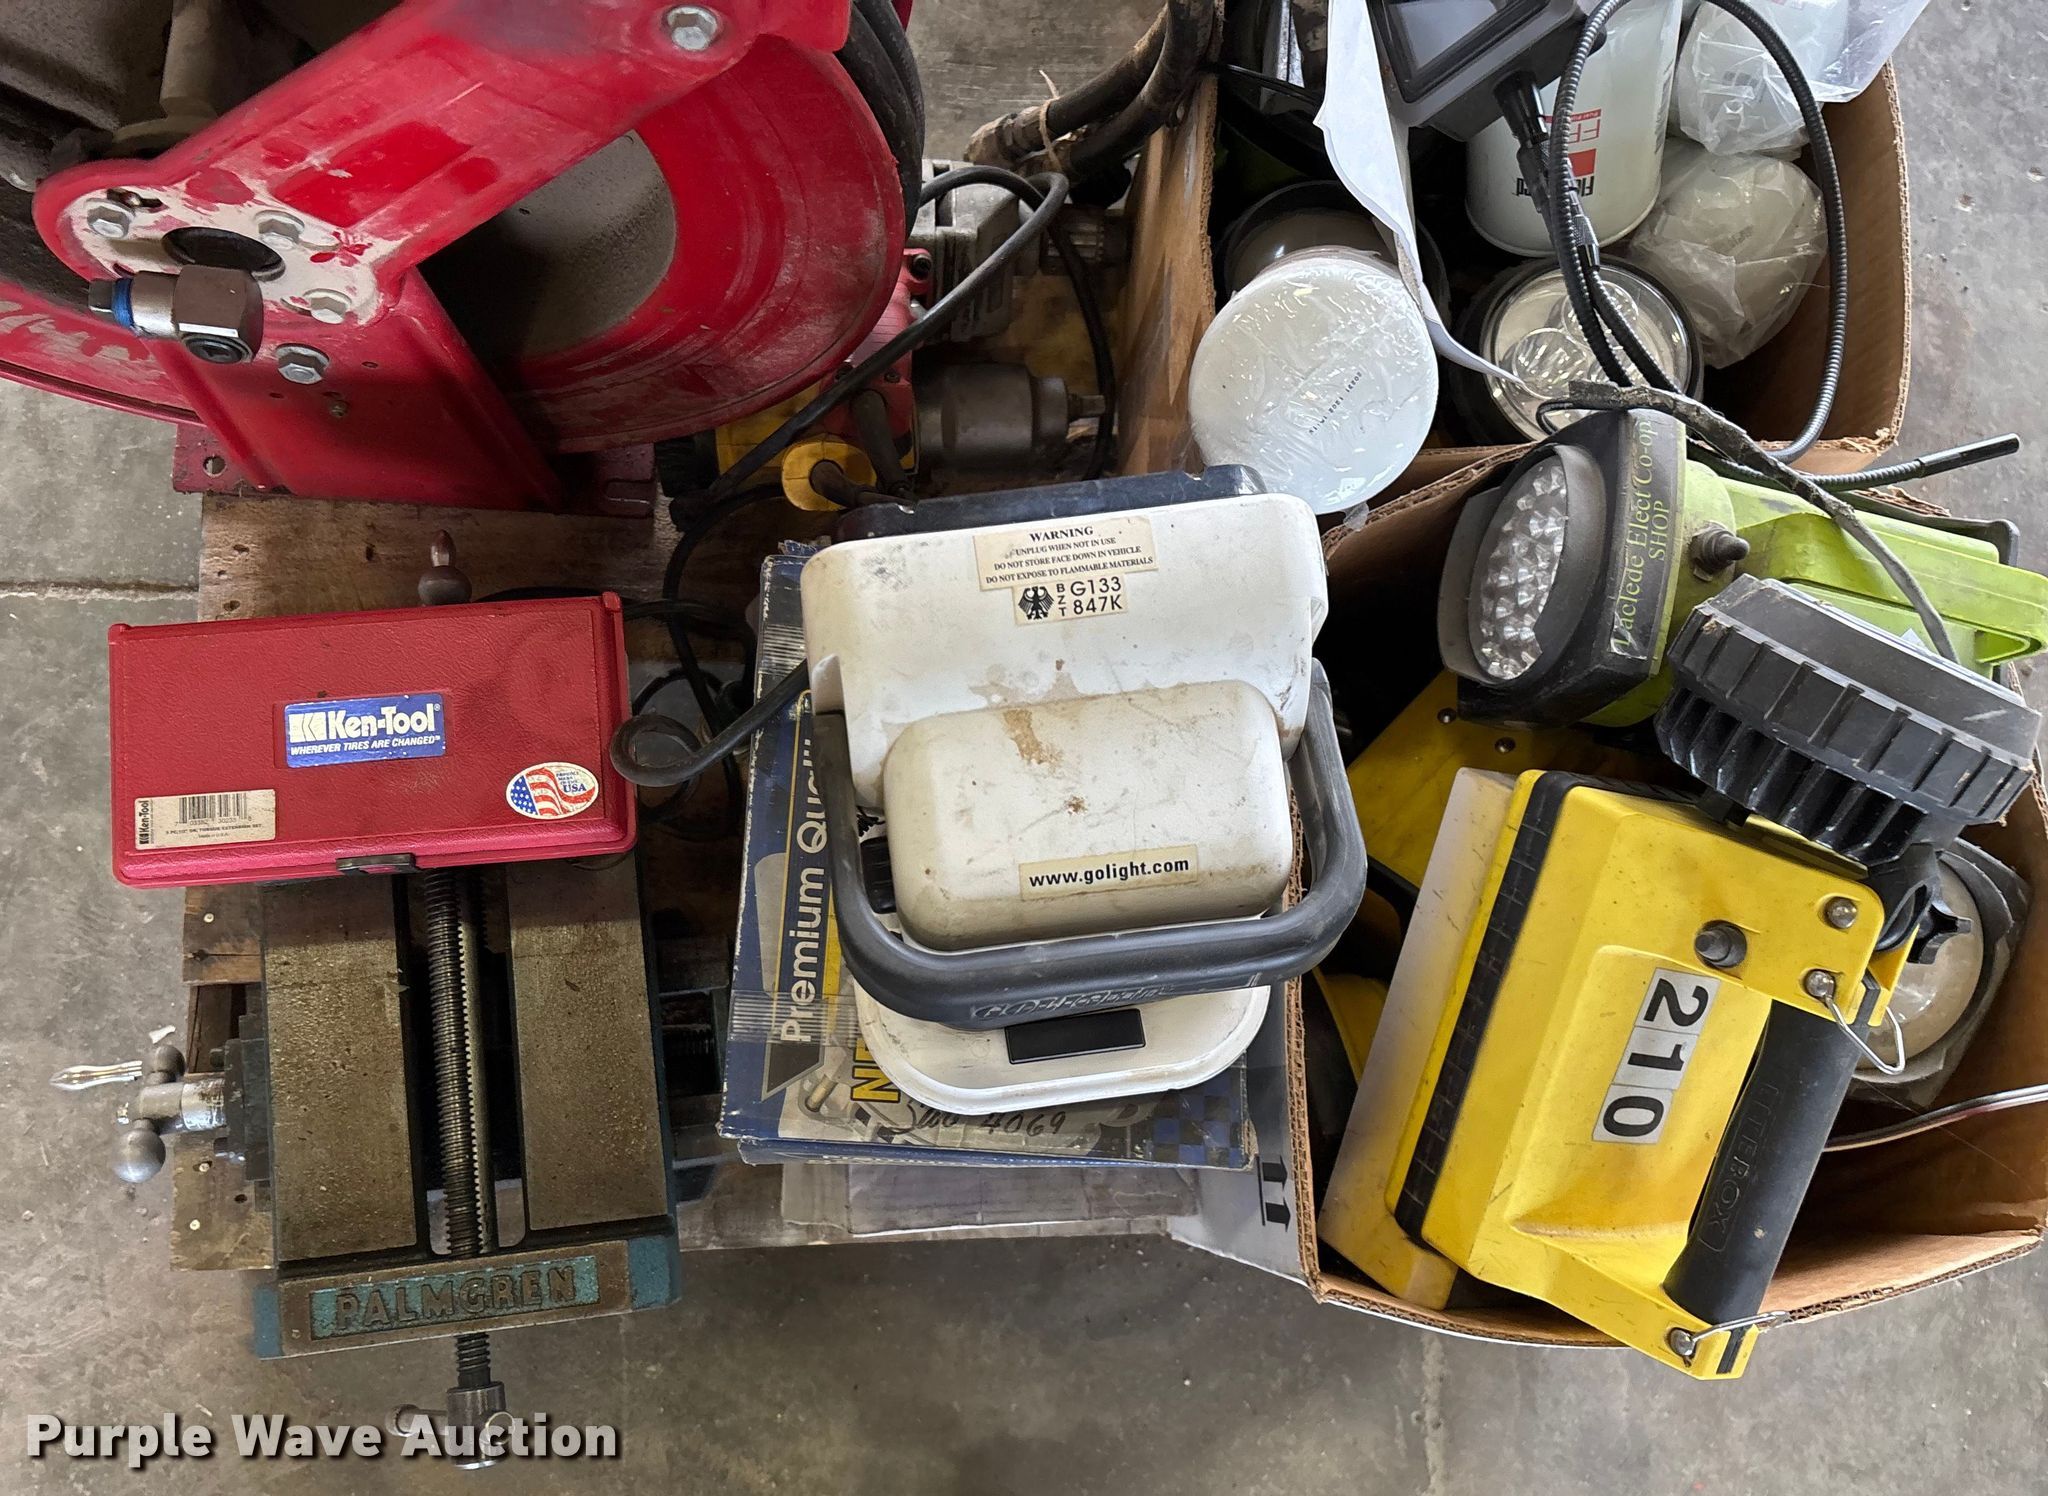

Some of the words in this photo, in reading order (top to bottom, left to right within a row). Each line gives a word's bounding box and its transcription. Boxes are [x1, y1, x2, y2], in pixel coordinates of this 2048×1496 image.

[1631, 420, 1658, 490] Co-op
[1627, 488, 1652, 548] Elect
[1650, 500, 1670, 561] SHOP
[1016, 546, 1048, 556] UNPLUG
[1048, 544, 1072, 552] WHEN
[1073, 542, 1090, 550] NOT
[1091, 540, 1100, 548] IN
[1100, 538, 1116, 546] USE
[1029, 526, 1094, 542] WARNING
[986, 576, 998, 584] DO
[1000, 574, 1016, 582] NOT
[1017, 570, 1047, 580] EXPOSE
[1048, 568, 1060, 576] TO
[1060, 563, 1108, 575] FLAMMABLE
[1108, 556, 1154, 569] MATERIALS
[994, 562, 1006, 570] DO
[1008, 560, 1024, 569] NOT
[1025, 557, 1050, 567] STORE
[1052, 554, 1072, 564] FACE
[1072, 552, 1097, 561] DOWN
[1098, 550, 1107, 558] IN
[1108, 546, 1142, 556] VEHICLE
[1070, 576, 1122, 596] G133
[1073, 594, 1123, 615] 847K
[1612, 555, 1646, 648] Laclede
[290, 743, 341, 756] WHEREVER
[343, 740, 370, 752] TIRES
[371, 739, 390, 749] ARE
[392, 736, 436, 747] CHANGED
[563, 783, 586, 793] USA
[1029, 860, 1189, 887] www.golight.com
[780, 867, 825, 1042] Premium
[1603, 978, 1709, 1137] 210
[980, 1111, 1066, 1137] 4069
[333, 1265, 578, 1331] PALMGREN
